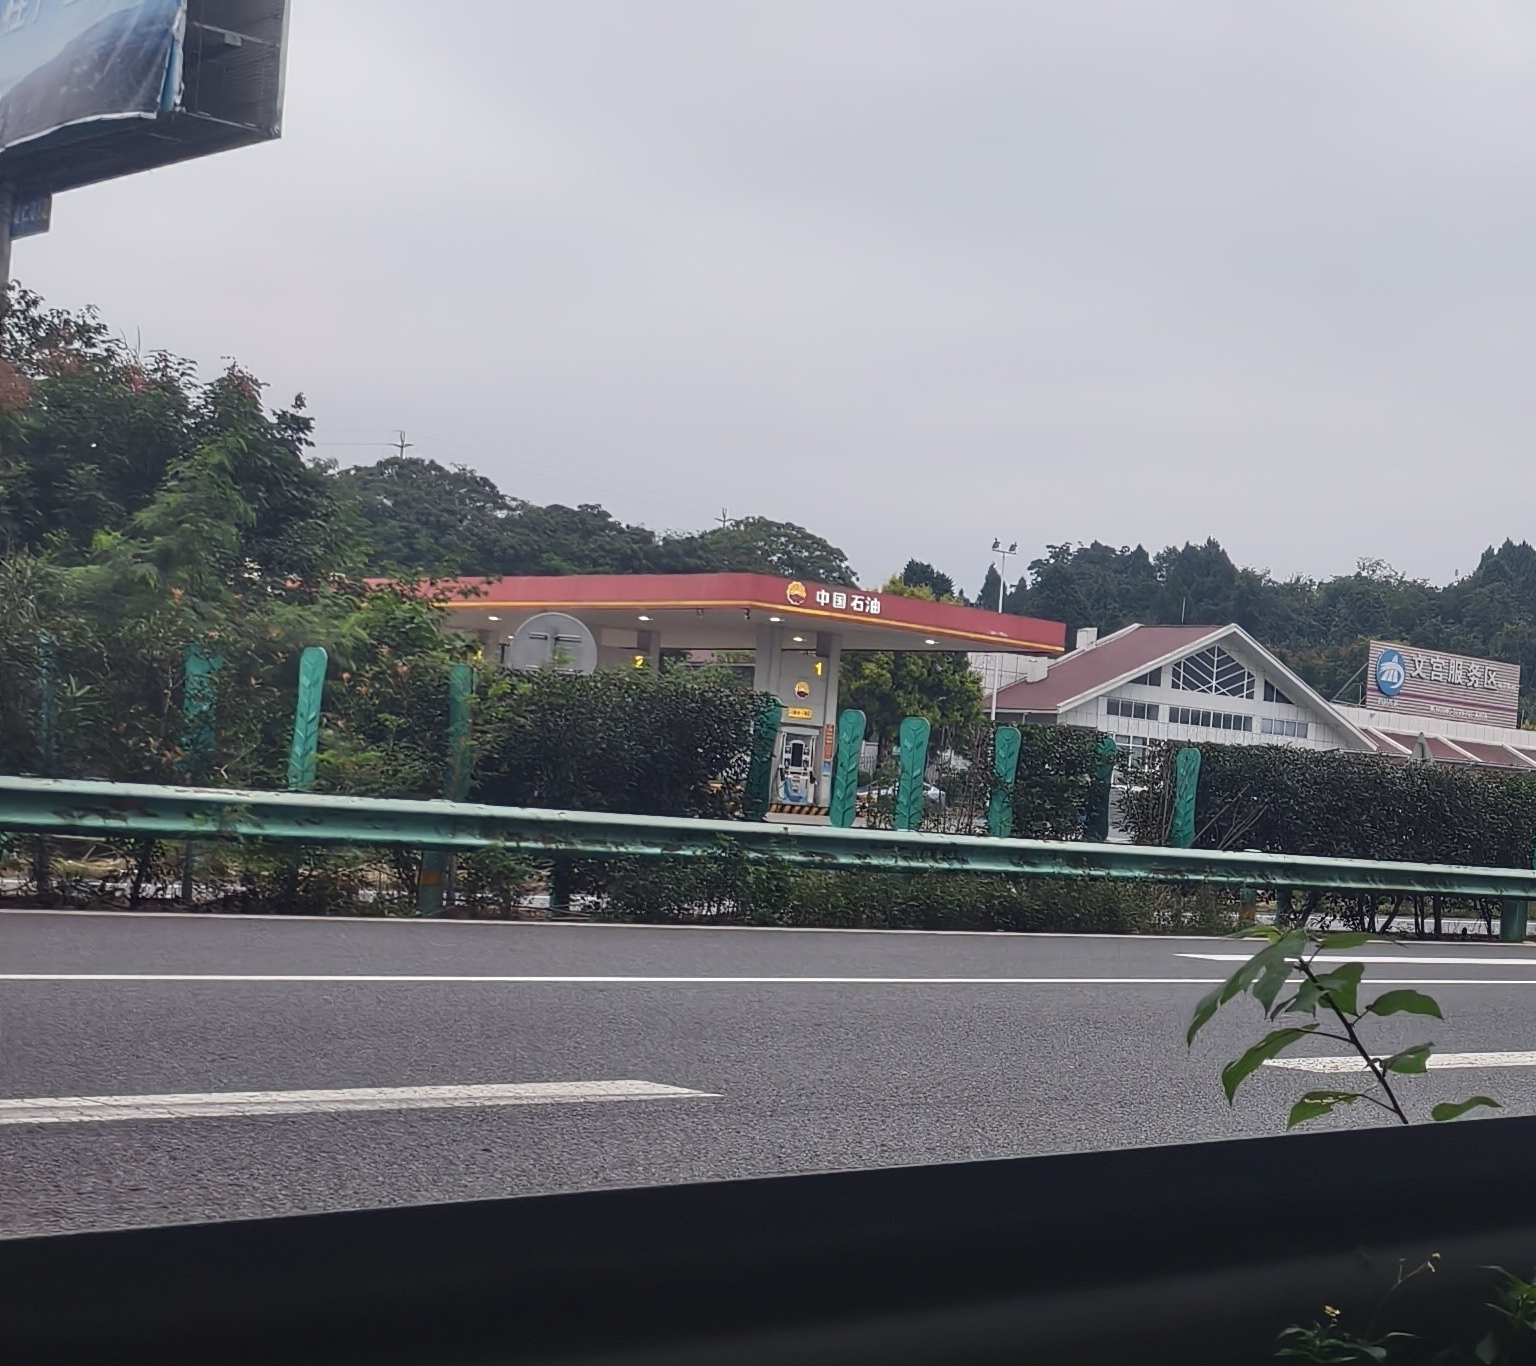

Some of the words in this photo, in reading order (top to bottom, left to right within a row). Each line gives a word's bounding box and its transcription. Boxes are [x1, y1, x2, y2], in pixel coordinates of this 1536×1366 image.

[816, 589, 881, 614] 中国石油
[814, 661, 823, 676] 1
[1410, 654, 1498, 690] 文宫服务区
